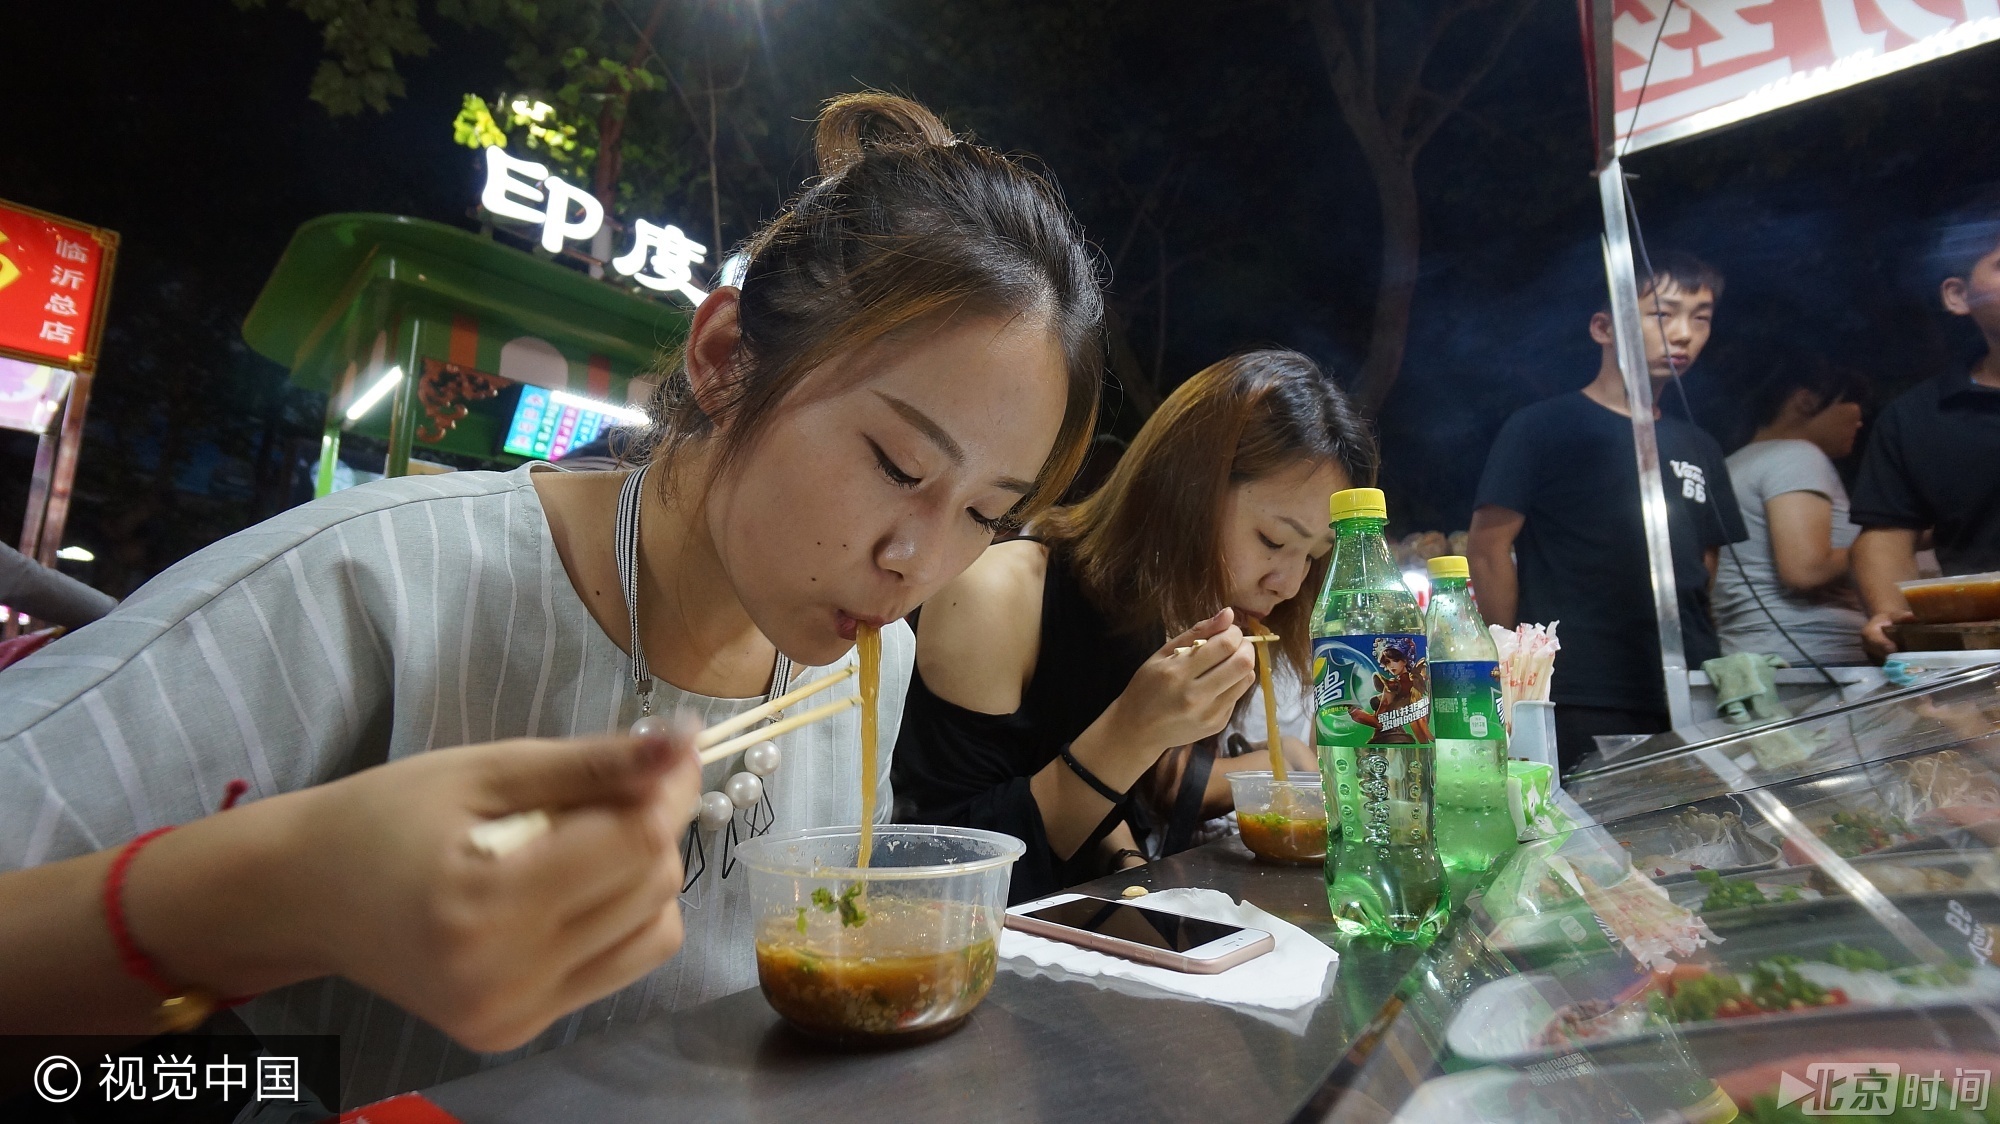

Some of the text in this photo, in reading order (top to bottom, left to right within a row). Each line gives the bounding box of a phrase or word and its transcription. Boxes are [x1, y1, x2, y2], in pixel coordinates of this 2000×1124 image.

[481, 144, 711, 308] 印度
[39, 239, 89, 344] 临沂总店
[1682, 478, 1707, 504] 66
